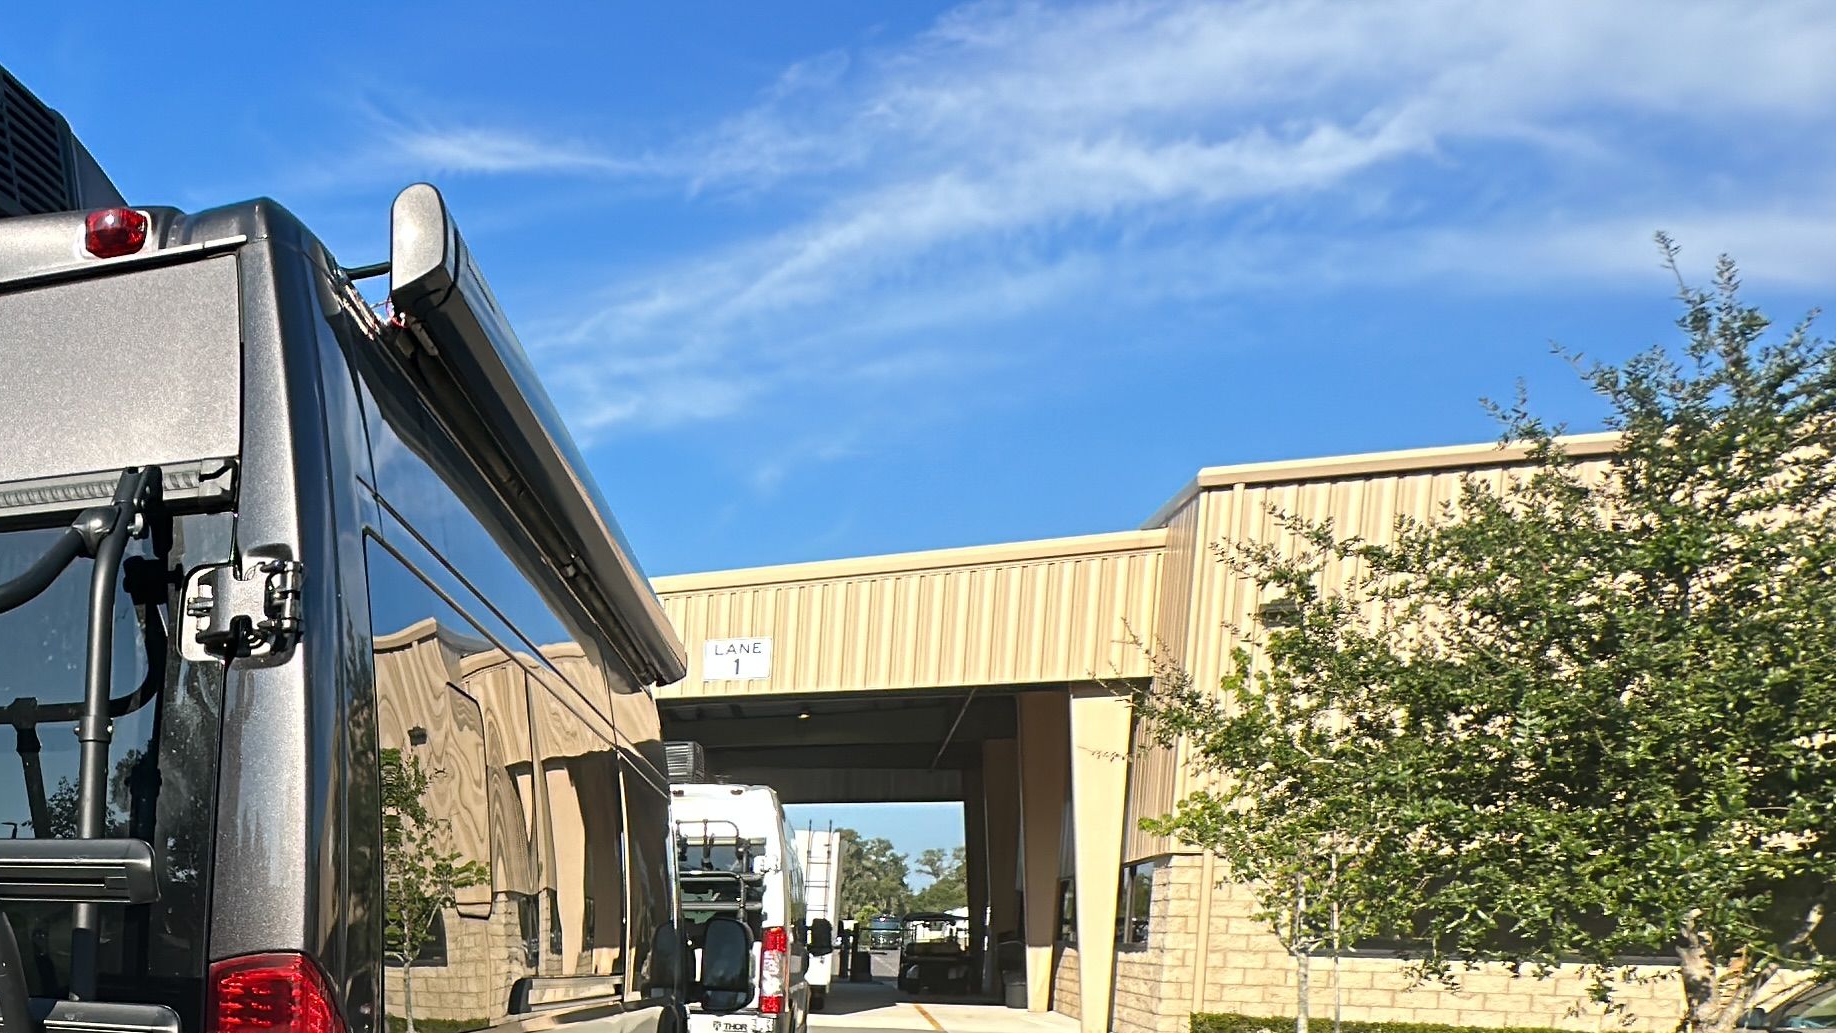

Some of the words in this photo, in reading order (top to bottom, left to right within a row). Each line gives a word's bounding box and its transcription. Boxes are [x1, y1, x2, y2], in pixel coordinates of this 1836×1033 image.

[715, 642, 762, 656] LANE
[733, 658, 740, 675] 1
[724, 1022, 748, 1031] THOR
